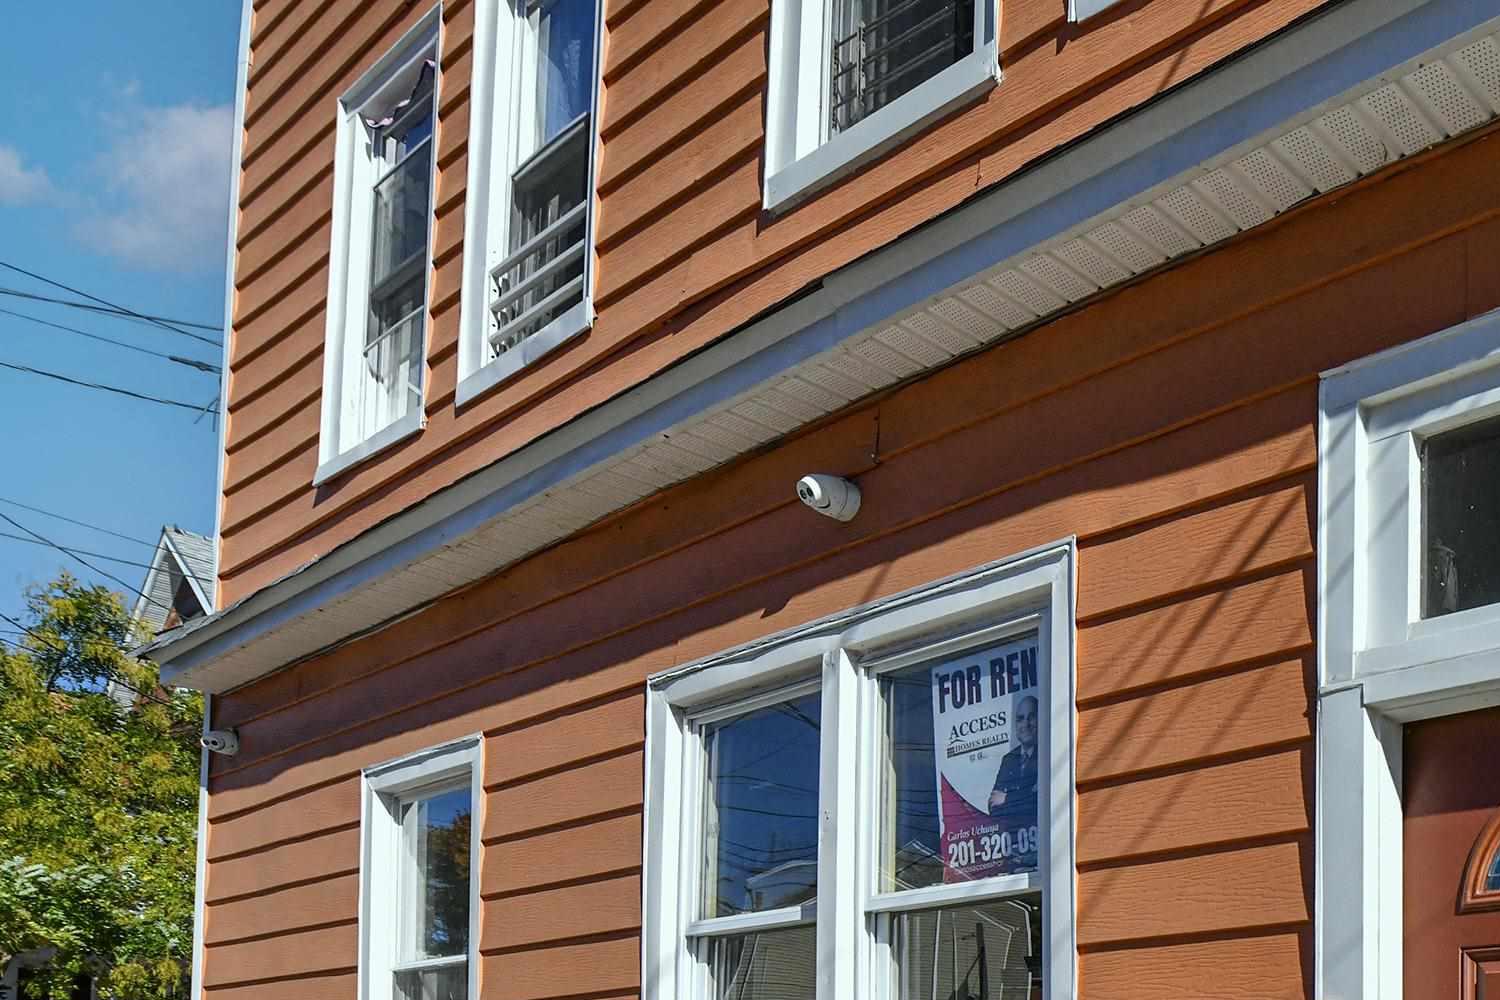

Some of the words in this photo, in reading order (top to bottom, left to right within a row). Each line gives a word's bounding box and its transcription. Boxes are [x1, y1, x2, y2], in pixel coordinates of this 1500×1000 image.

[938, 665, 982, 713] FOR
[990, 645, 1039, 699] REN
[949, 711, 1007, 740] ACCESS
[947, 829, 970, 841] Carlos
